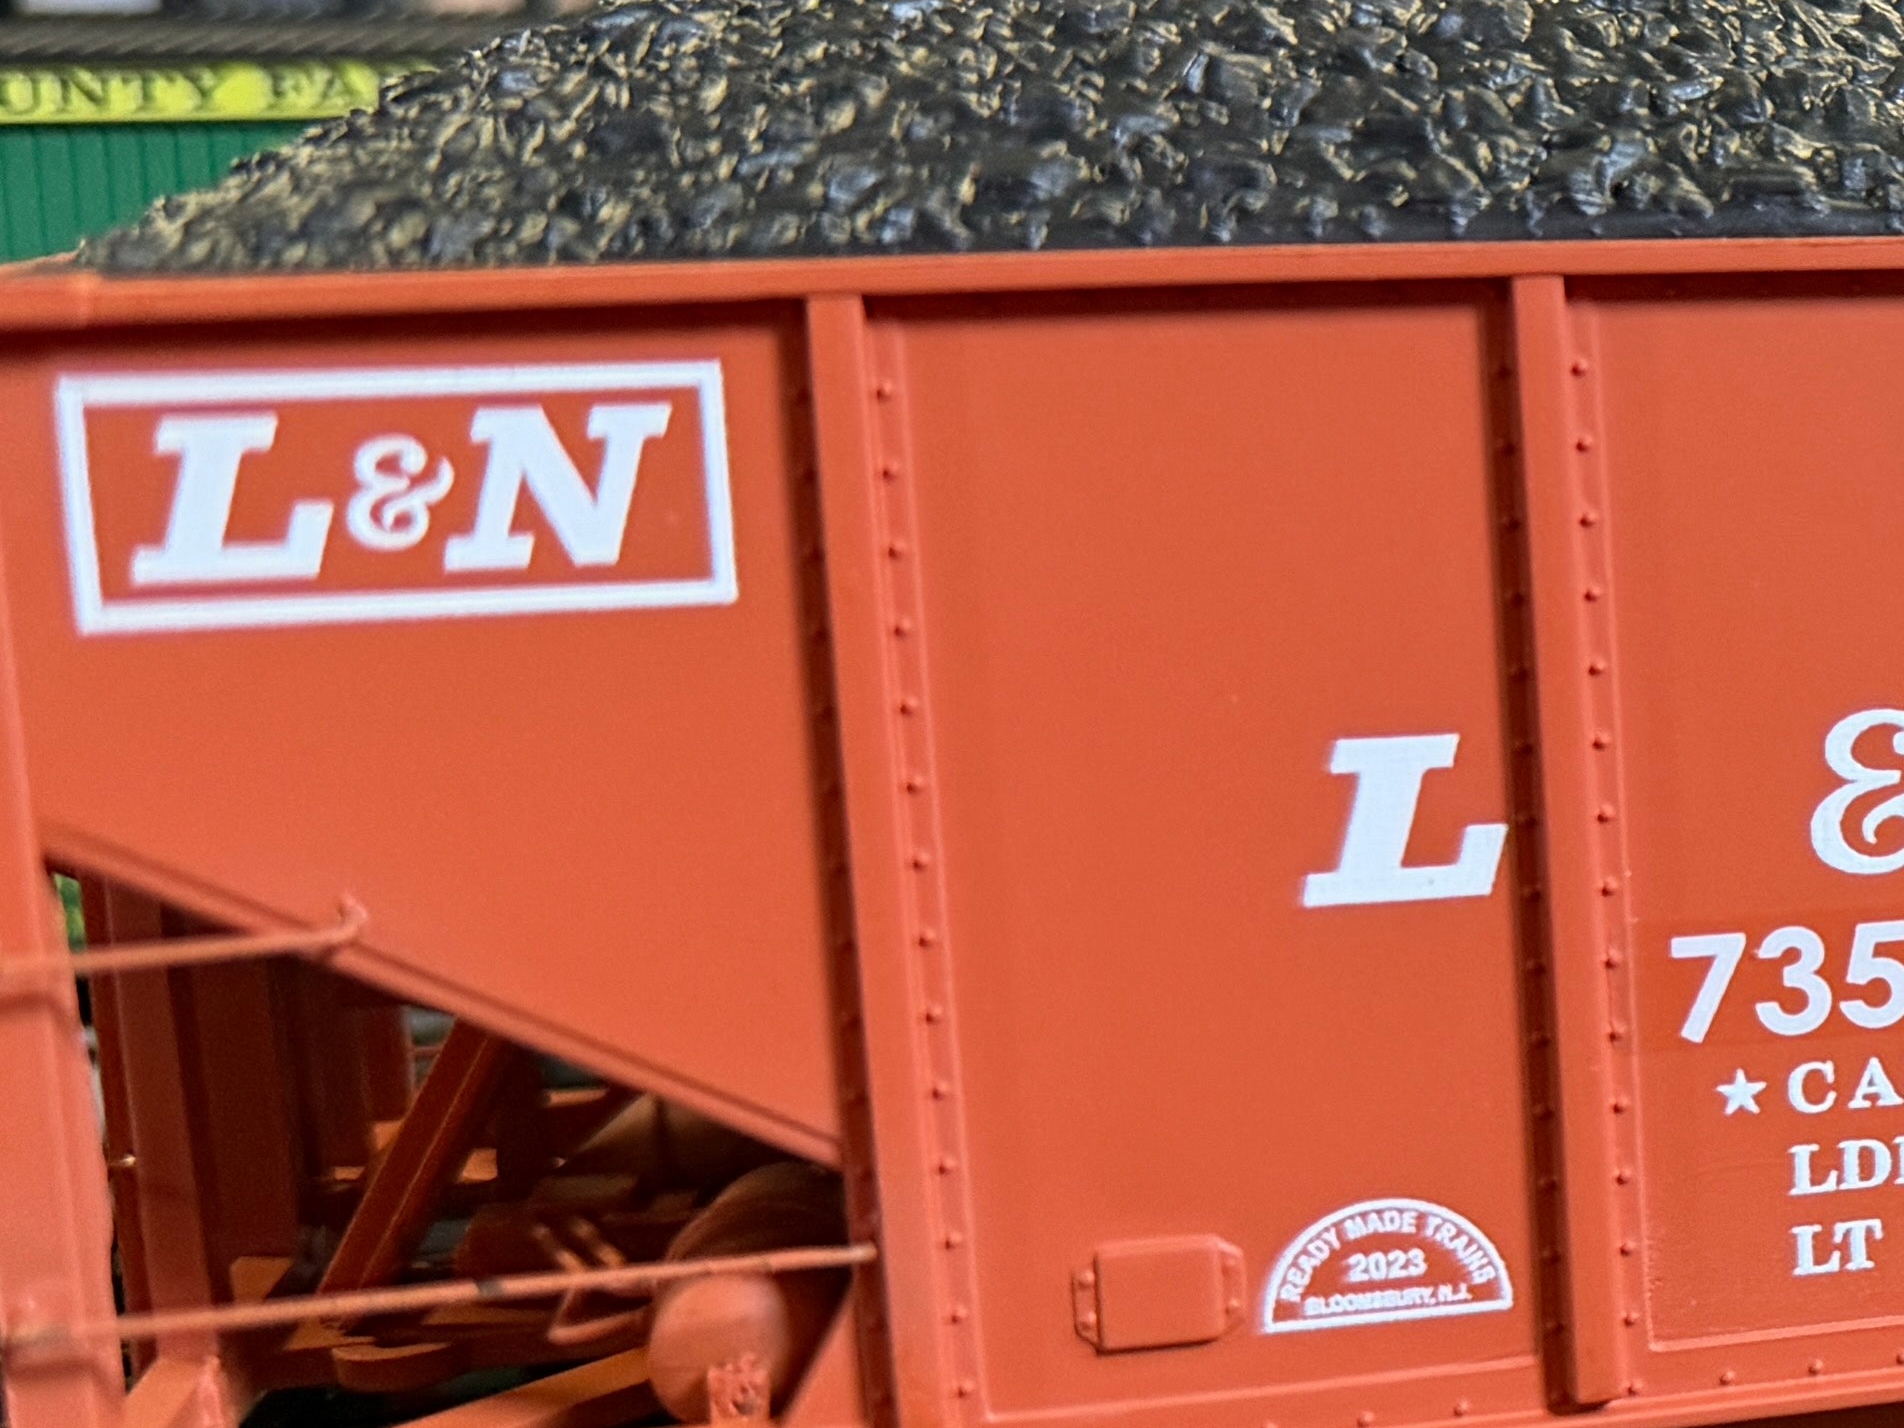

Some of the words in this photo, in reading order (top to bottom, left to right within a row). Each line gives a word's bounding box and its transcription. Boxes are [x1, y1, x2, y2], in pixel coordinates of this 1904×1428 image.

[130, 402, 673, 586] L&N
[1300, 732, 1509, 910] L
[1278, 1226, 1342, 1303] READY
[1342, 1209, 1419, 1241] MADE
[1423, 1213, 1498, 1285] TRAINS
[1345, 1247, 1429, 1282] 2023
[1790, 1217, 1884, 1278] LT
